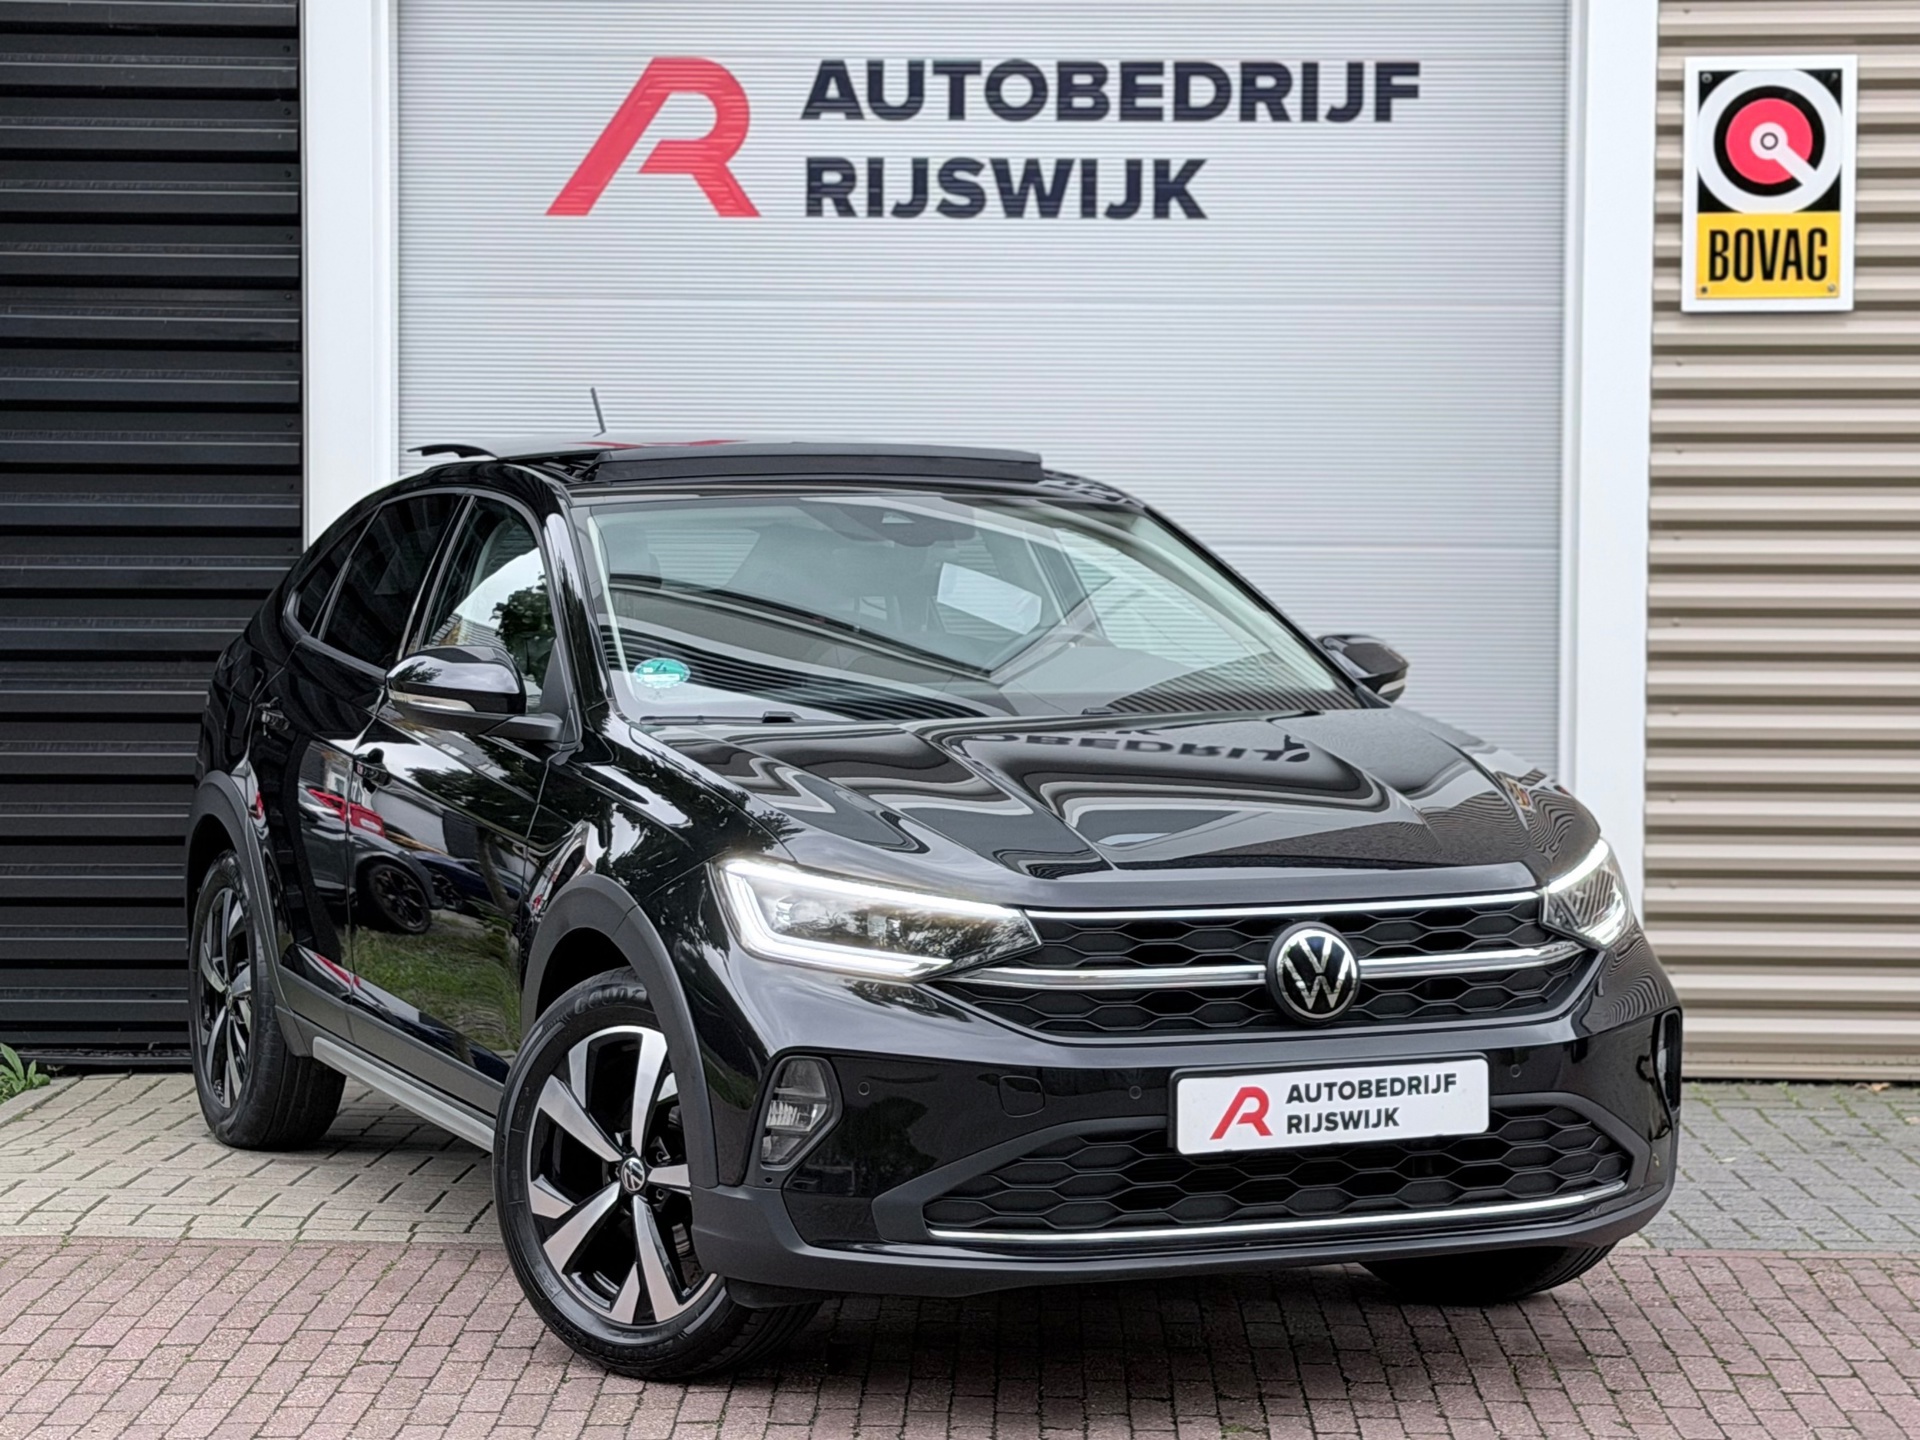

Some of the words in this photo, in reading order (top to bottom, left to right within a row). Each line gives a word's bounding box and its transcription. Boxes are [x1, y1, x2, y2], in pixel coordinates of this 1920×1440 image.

[802, 59, 1420, 123] AUTOBEDRIJF
[805, 157, 1207, 219] RIJSWIJK
[1708, 227, 1828, 283] BOVAG
[1285, 1073, 1457, 1105] AUTOBEDRIJF
[1286, 1107, 1400, 1135] RIJSWIJK
